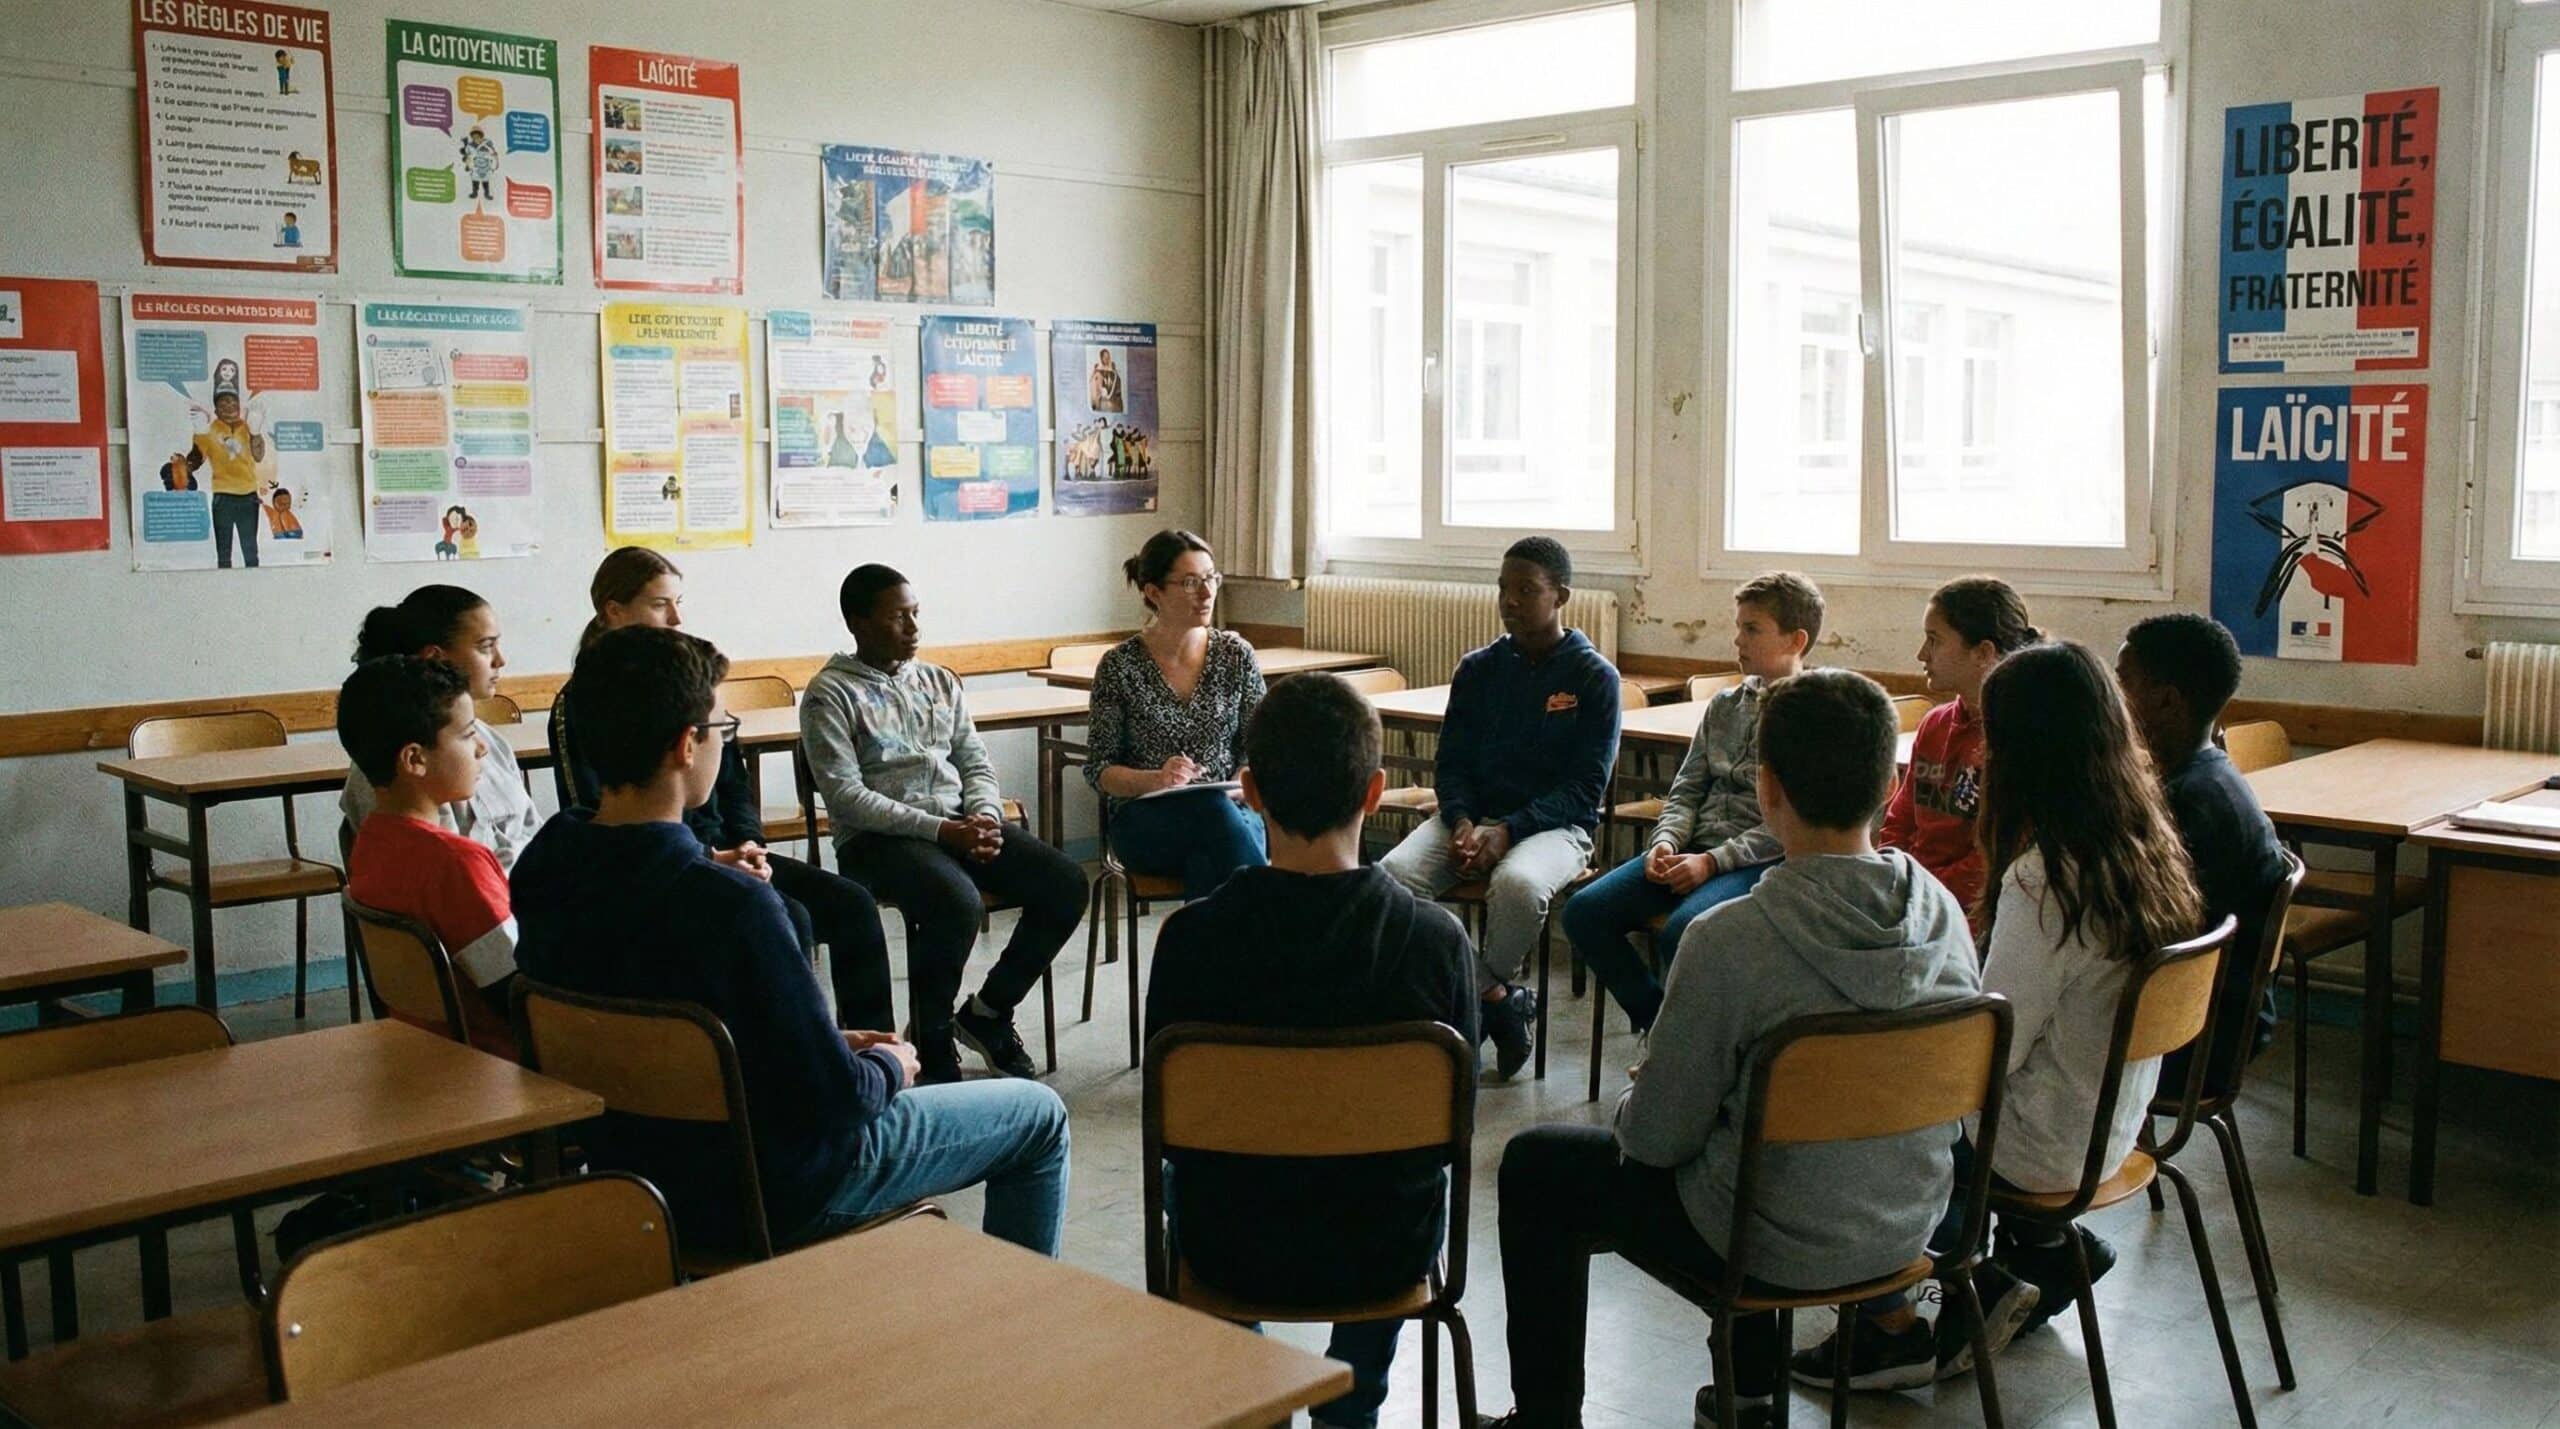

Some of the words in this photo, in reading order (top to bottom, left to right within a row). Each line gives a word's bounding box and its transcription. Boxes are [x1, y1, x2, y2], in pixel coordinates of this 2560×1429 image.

[140, 0, 178, 26] LES
[183, 0, 259, 36] RÈGLES
[263, 13, 289, 39] DE
[293, 16, 324, 43] VIE
[401, 29, 424, 56] LA
[428, 33, 547, 71] CITOYENNETÉ
[638, 58, 698, 88] LAÏCITÉ
[2234, 99, 2430, 178] LIBERTÉ,
[2231, 177, 2426, 252] ÉGALITÉ,
[2229, 258, 2419, 312] FRATERNITÉ
[2231, 391, 2410, 462] LAÏCITÉ
